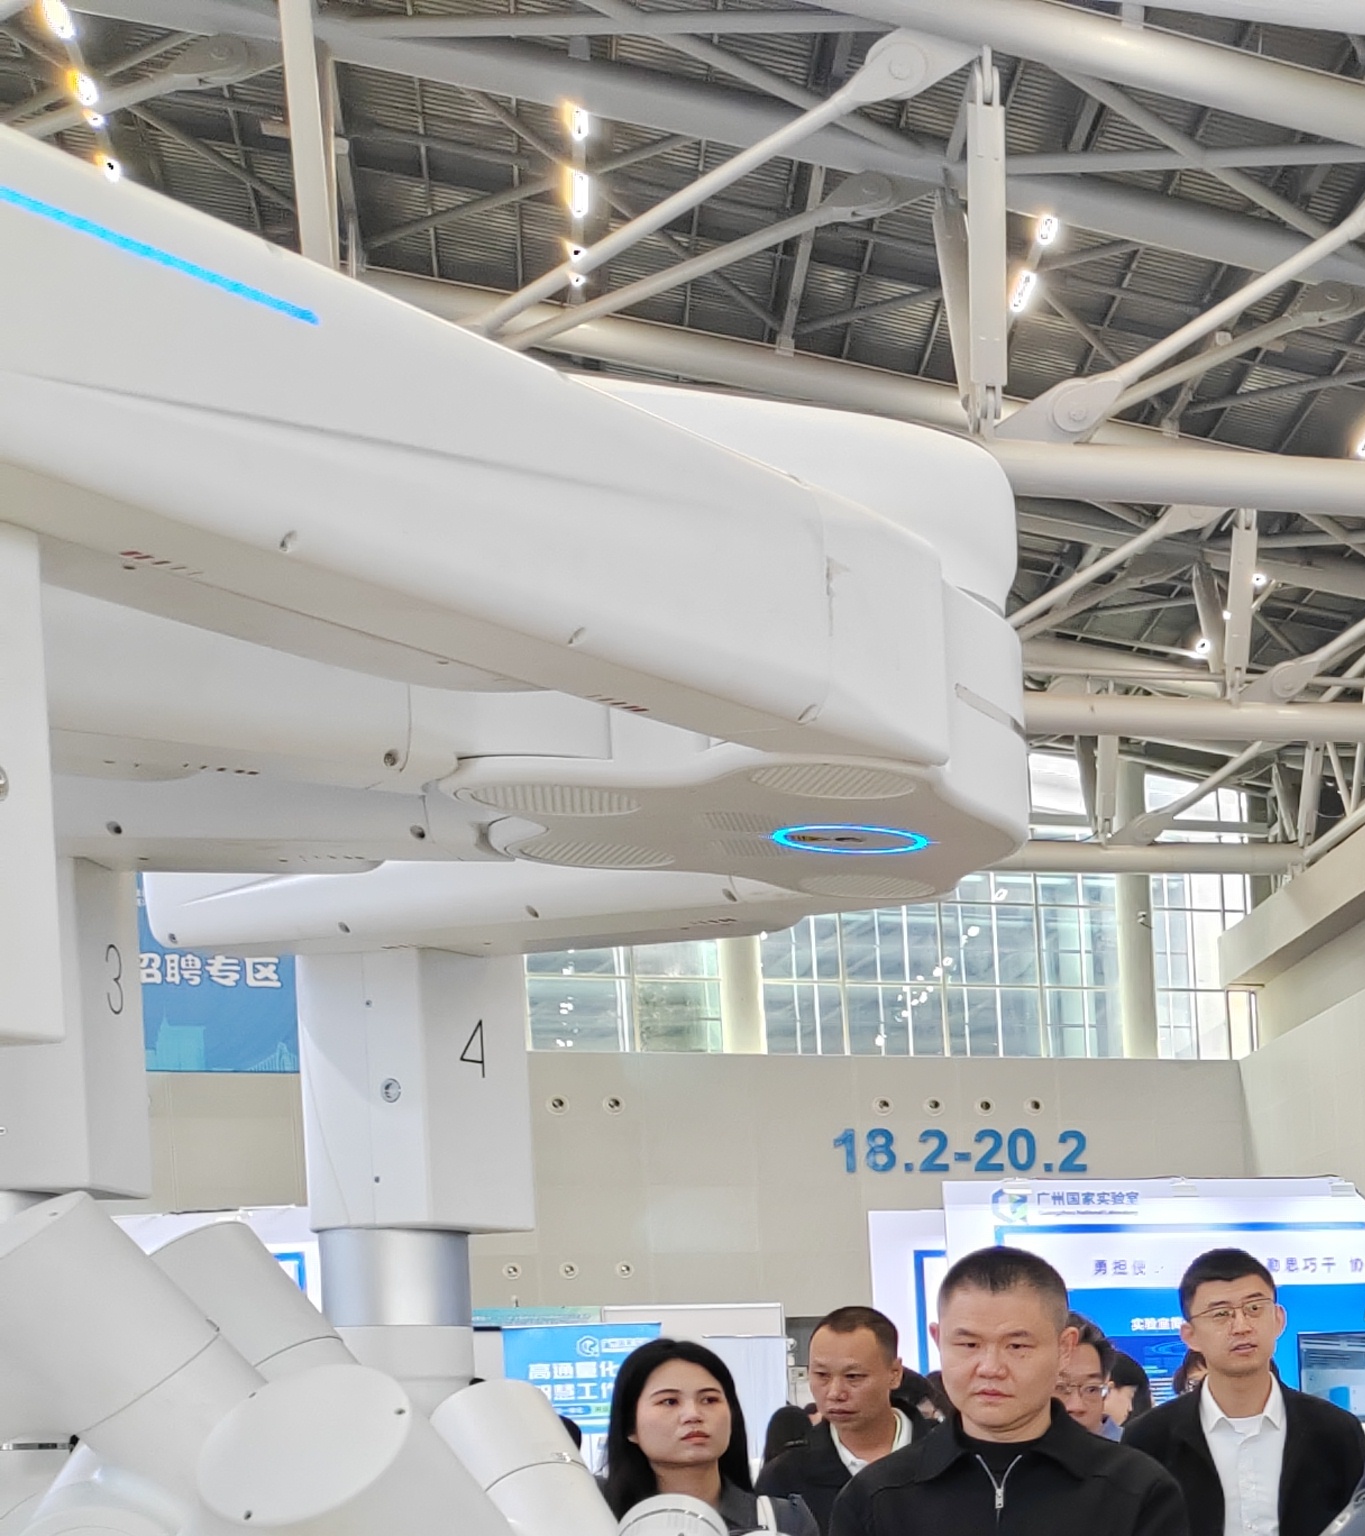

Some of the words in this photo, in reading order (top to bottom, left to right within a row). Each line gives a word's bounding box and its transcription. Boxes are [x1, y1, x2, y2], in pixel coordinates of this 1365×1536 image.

[107, 944, 123, 1015] 3
[460, 1019, 487, 1078] 4
[833, 1127, 1088, 1173] 18.2-20.2
[1037, 1191, 1139, 1205] 广州国家实验室
